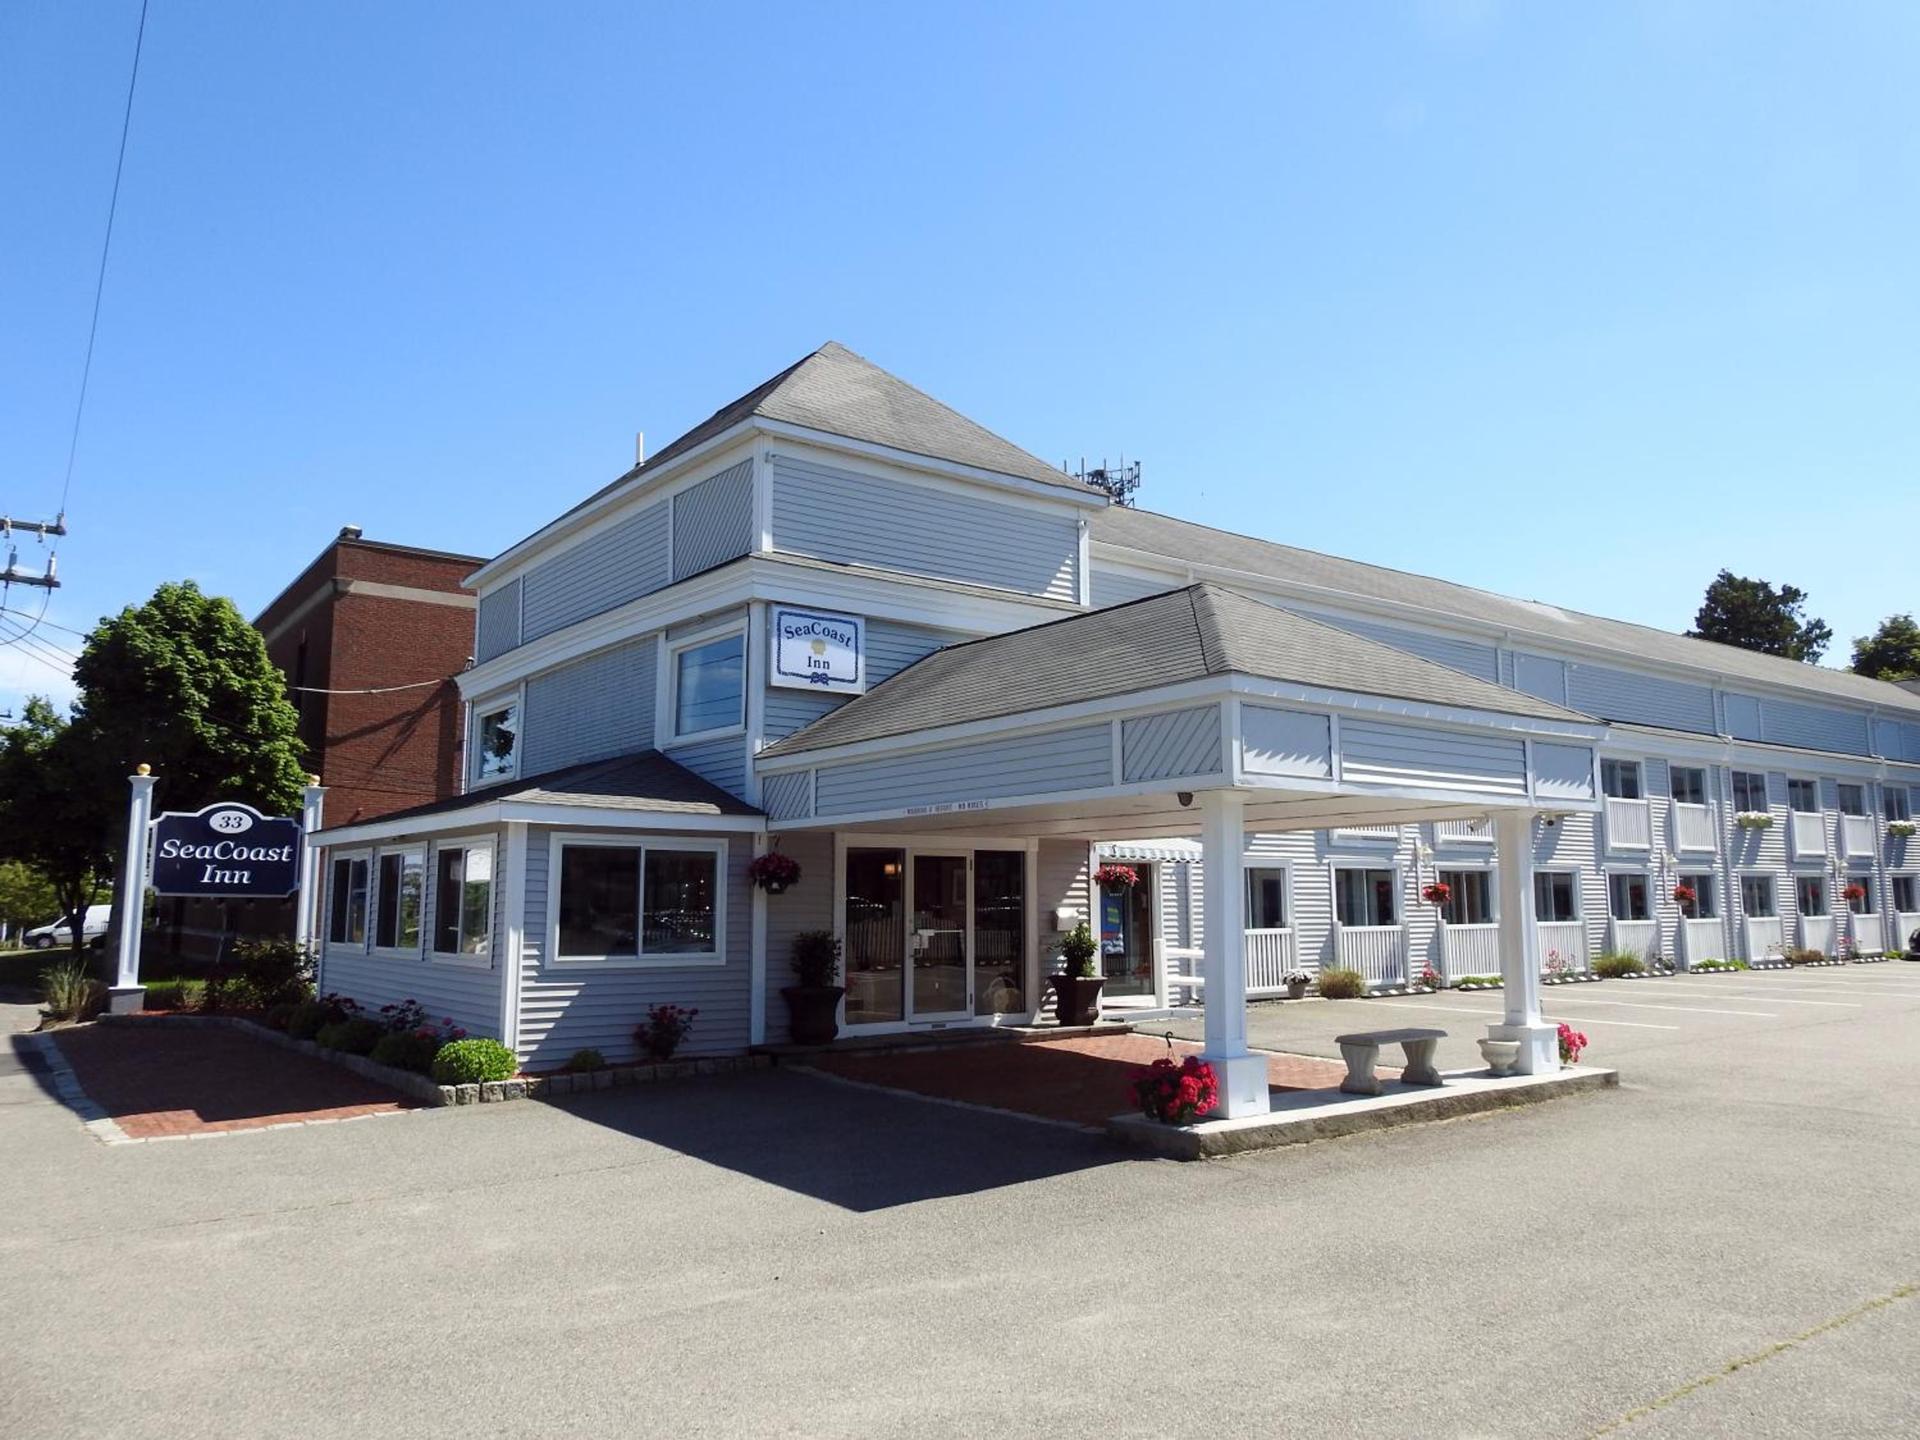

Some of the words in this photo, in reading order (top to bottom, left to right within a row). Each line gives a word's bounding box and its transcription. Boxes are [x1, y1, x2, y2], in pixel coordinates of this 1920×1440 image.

[784, 621, 852, 647] SeaCoast
[807, 656, 830, 670] Inn
[219, 816, 243, 828] 33
[159, 839, 293, 862] SeaCoast
[200, 864, 251, 884] Inn
